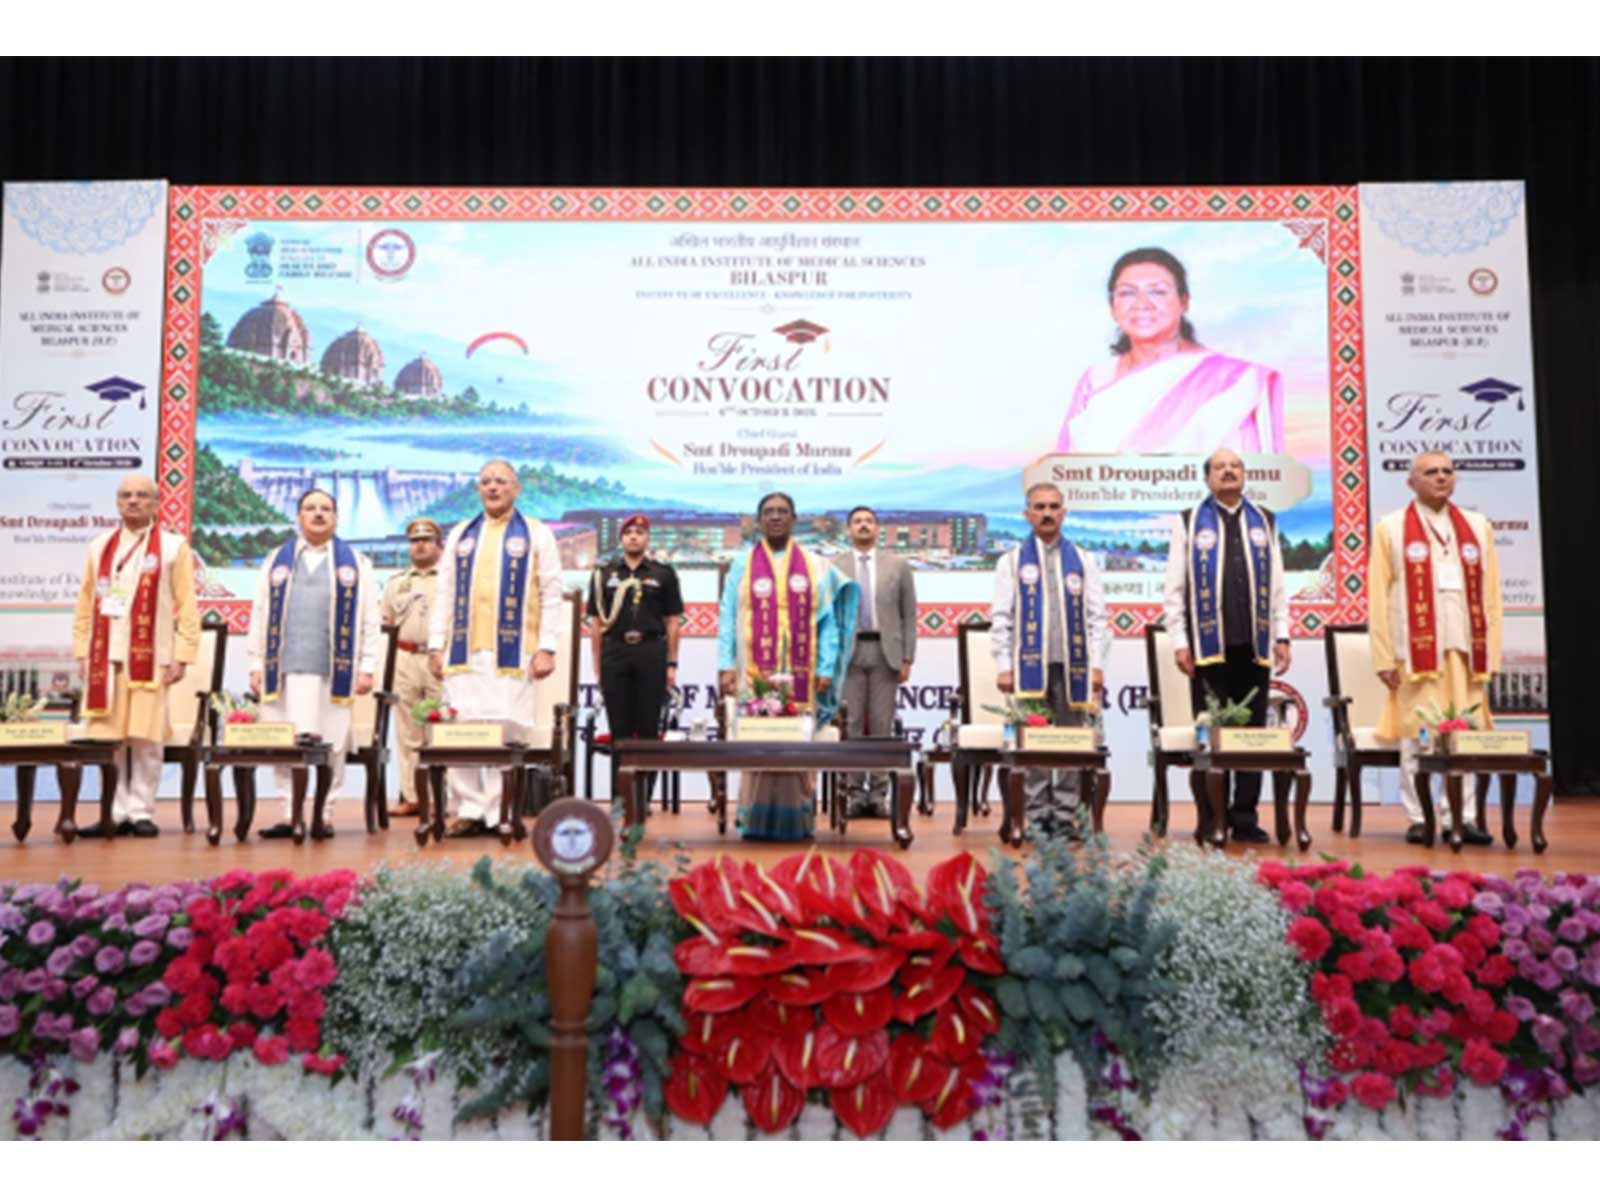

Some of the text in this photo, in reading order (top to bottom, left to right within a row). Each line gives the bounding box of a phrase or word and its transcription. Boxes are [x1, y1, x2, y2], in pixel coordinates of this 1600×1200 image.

[630, 256, 926, 268] ALL INDIA INSTITUTE OF MEDICAL SCIENCES
[729, 270, 828, 287] BILASPUR
[698, 331, 804, 373] First
[647, 376, 891, 403] CONVOCATION
[2, 389, 118, 431] First
[1376, 391, 1495, 433] First
[0, 437, 141, 451] CONVOCATION
[683, 441, 852, 461] Smt Droupadi Murmu
[740, 461, 795, 475] President
[796, 462, 809, 475] of
[812, 462, 842, 476] India
[1051, 463, 1093, 482] Smt
[1099, 463, 1197, 486] Droupadi
[1067, 487, 1128, 501] Hon'ble
